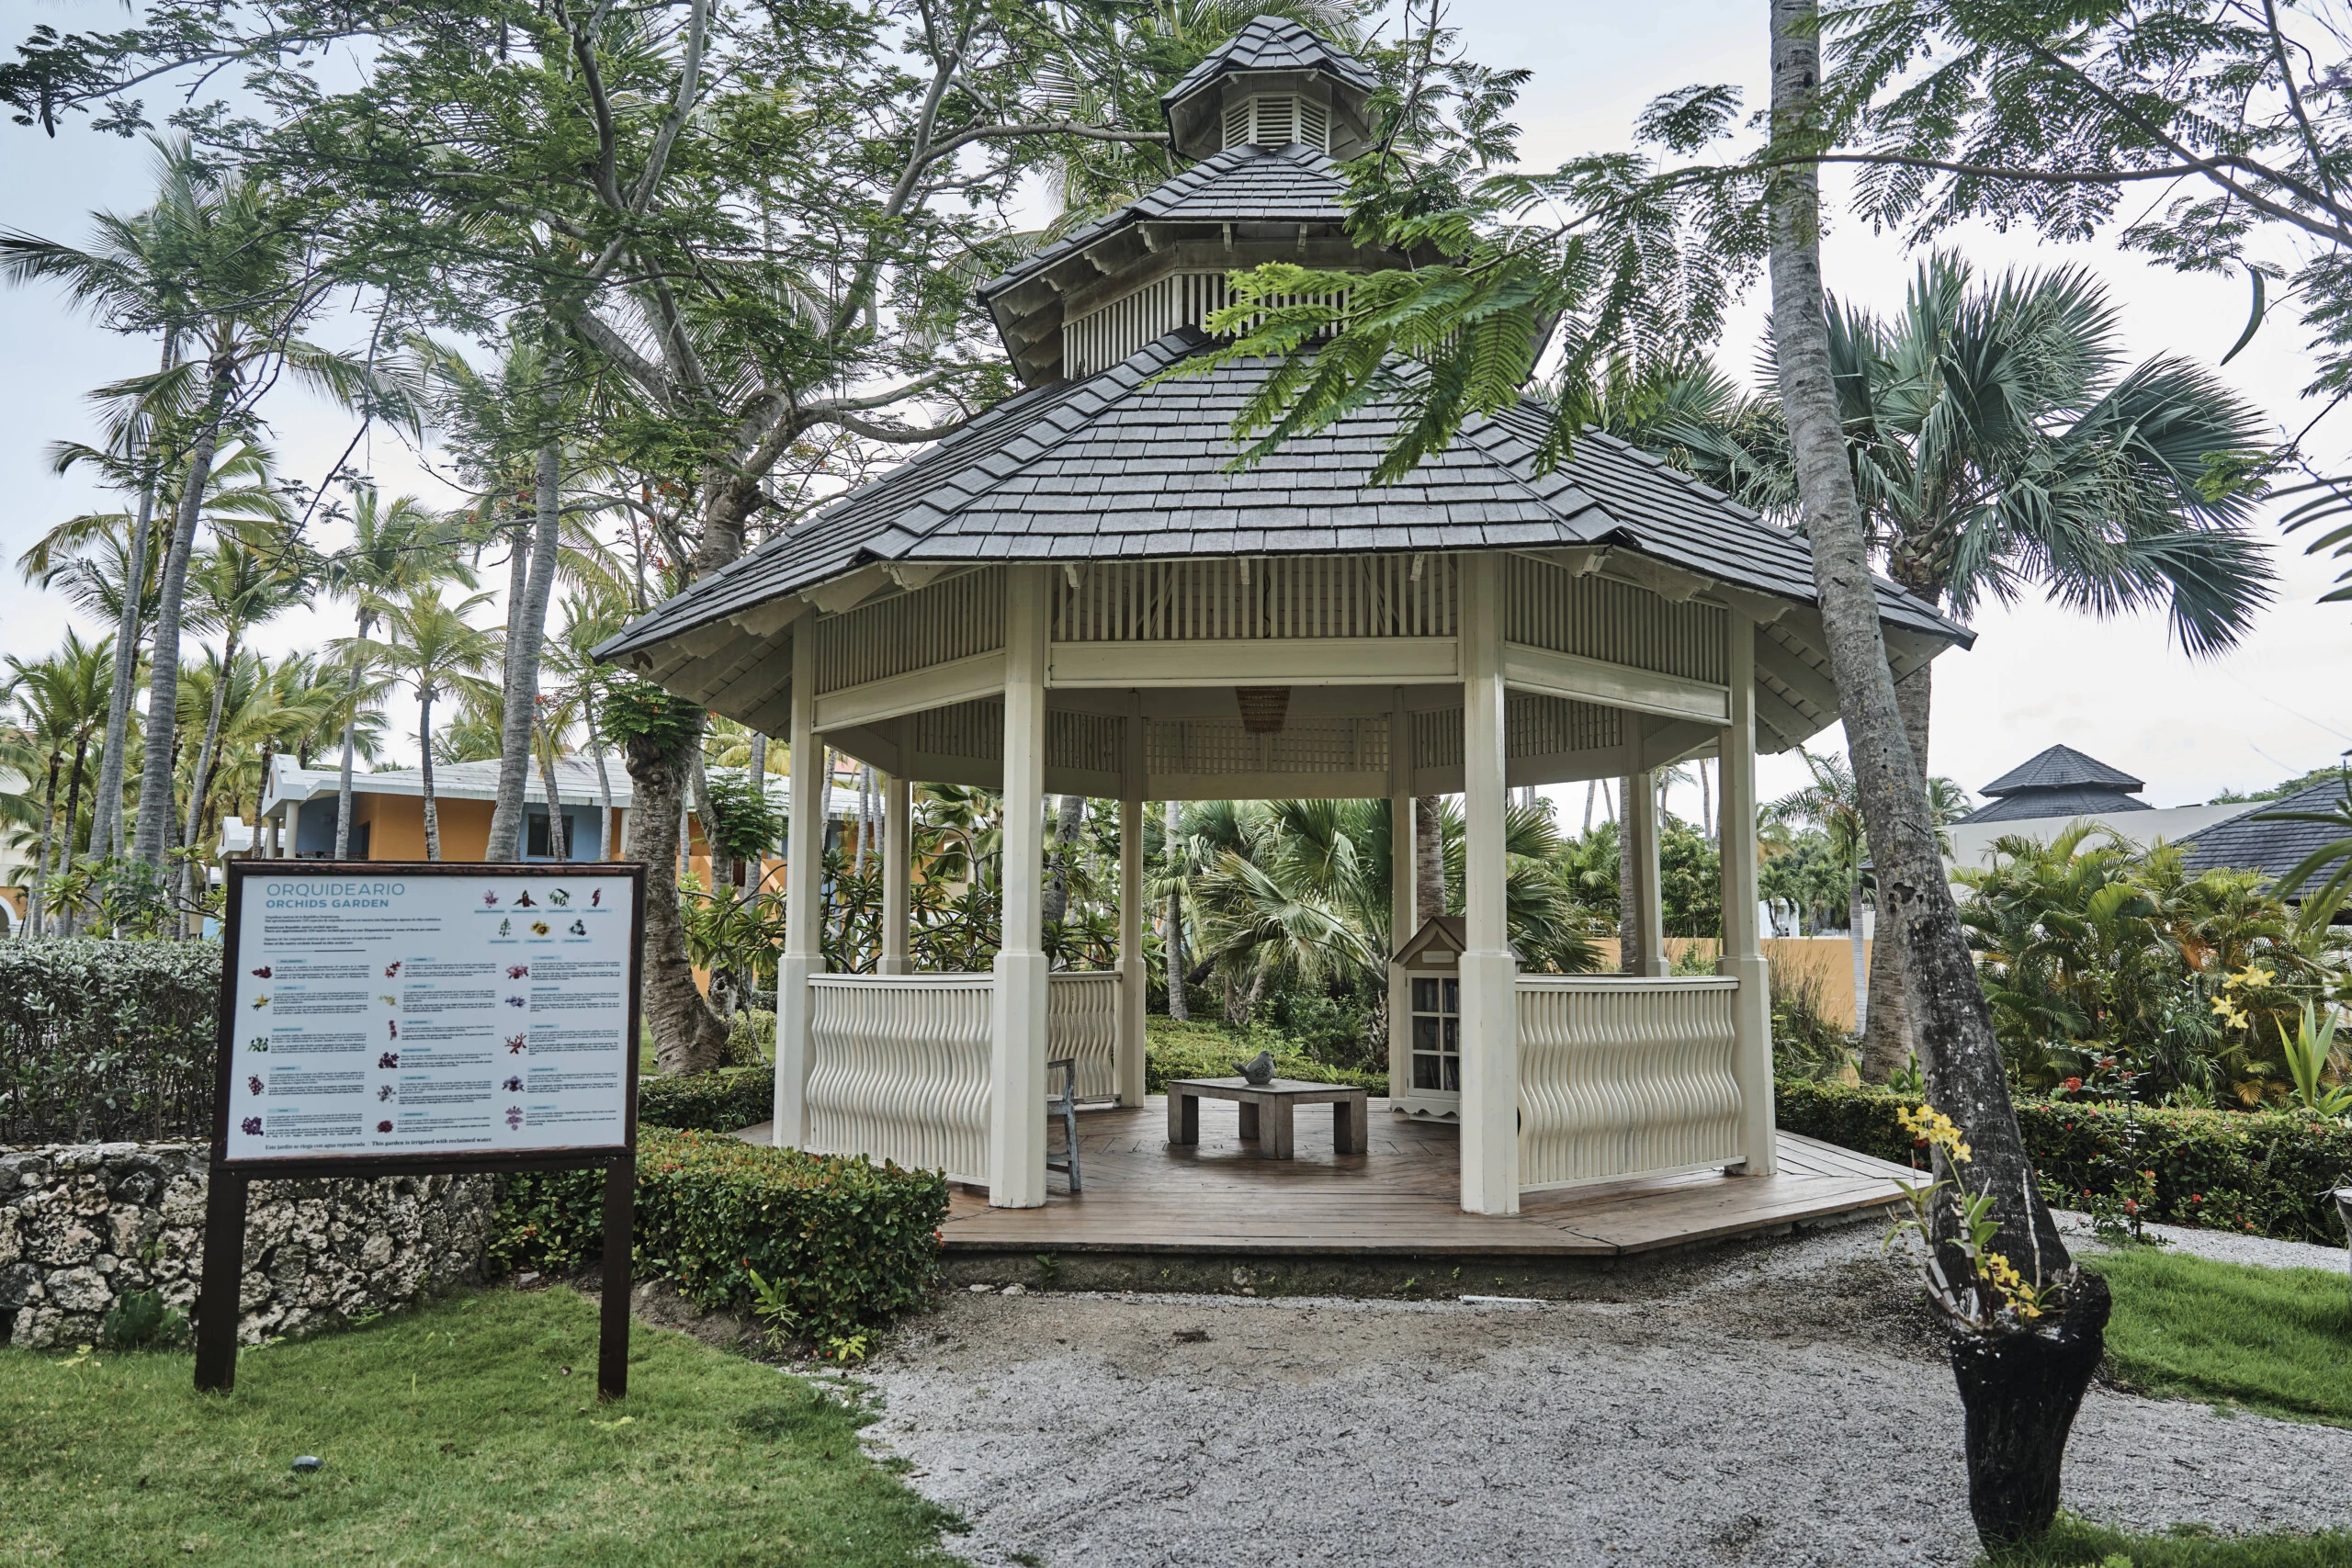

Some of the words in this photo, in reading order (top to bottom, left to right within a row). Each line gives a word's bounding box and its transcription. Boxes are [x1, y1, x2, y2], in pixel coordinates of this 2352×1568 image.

[266, 883, 405, 897] ORQUIDEARIO
[266, 899, 327, 908] ORCHIDS
[332, 899, 390, 908] GARDEN
